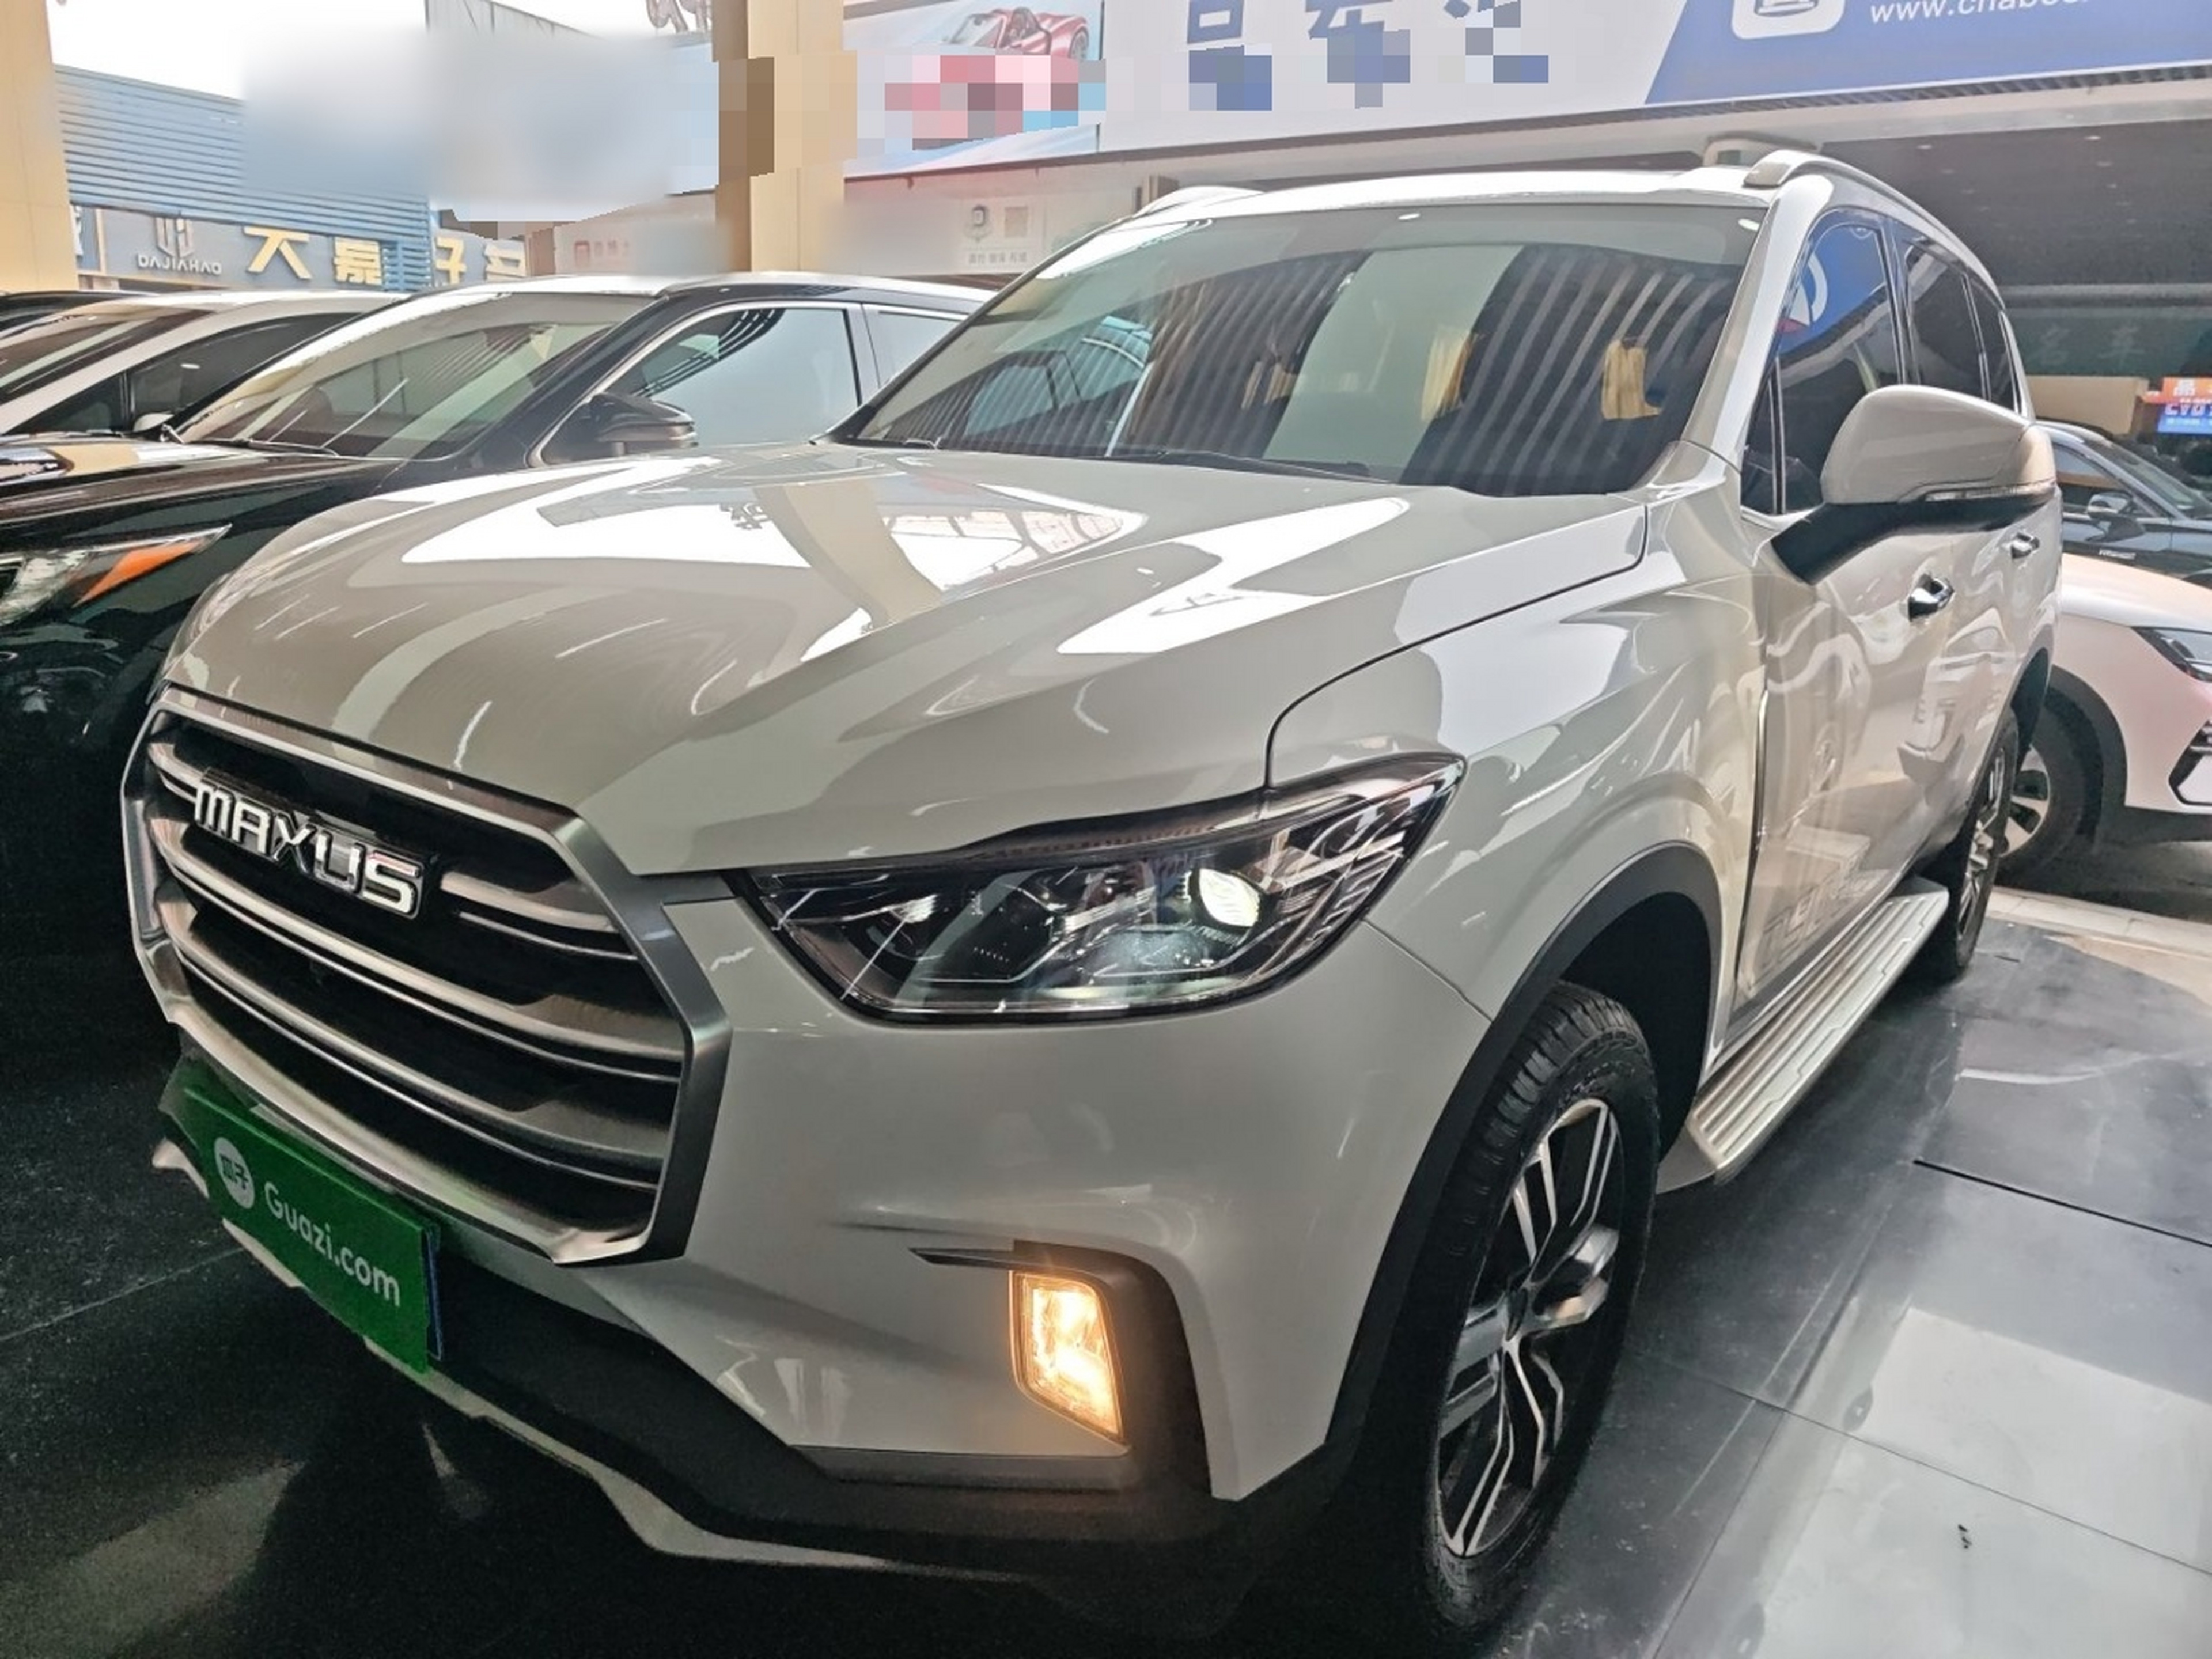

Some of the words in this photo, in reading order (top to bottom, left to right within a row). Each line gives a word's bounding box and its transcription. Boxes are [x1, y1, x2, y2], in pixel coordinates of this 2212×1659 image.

[137, 253, 222, 275] DAJIAHAO
[194, 781, 423, 917] MAXUS
[264, 1181, 400, 1308] Guazi.com
